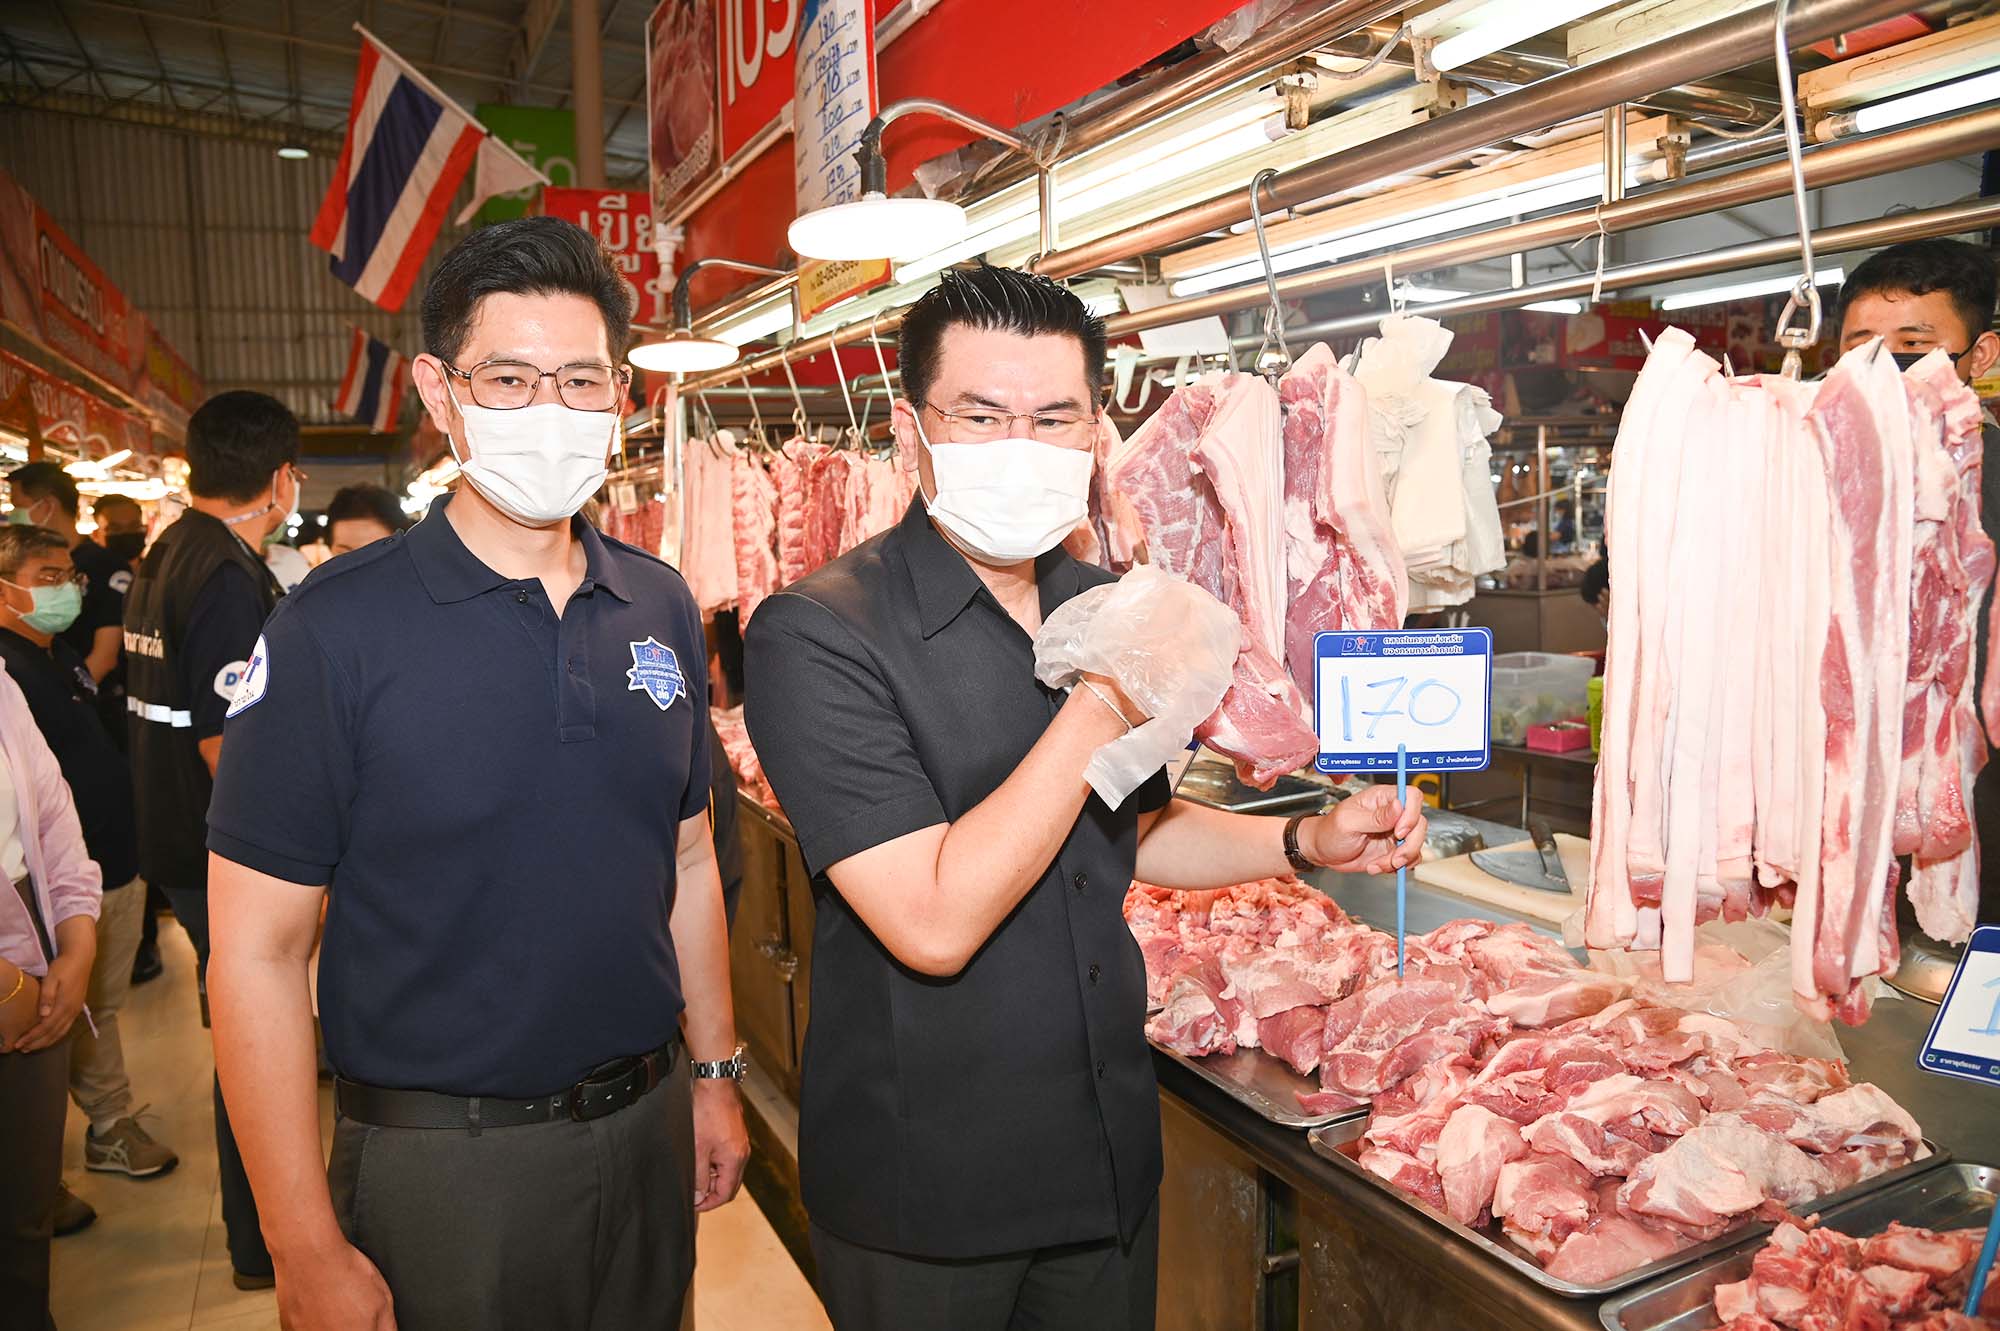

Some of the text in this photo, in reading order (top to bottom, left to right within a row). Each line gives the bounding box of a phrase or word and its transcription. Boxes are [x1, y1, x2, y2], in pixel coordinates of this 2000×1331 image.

[1383, 645, 1464, 655] ของกรมการค้าภายใน
[1341, 675, 1461, 742] 170
